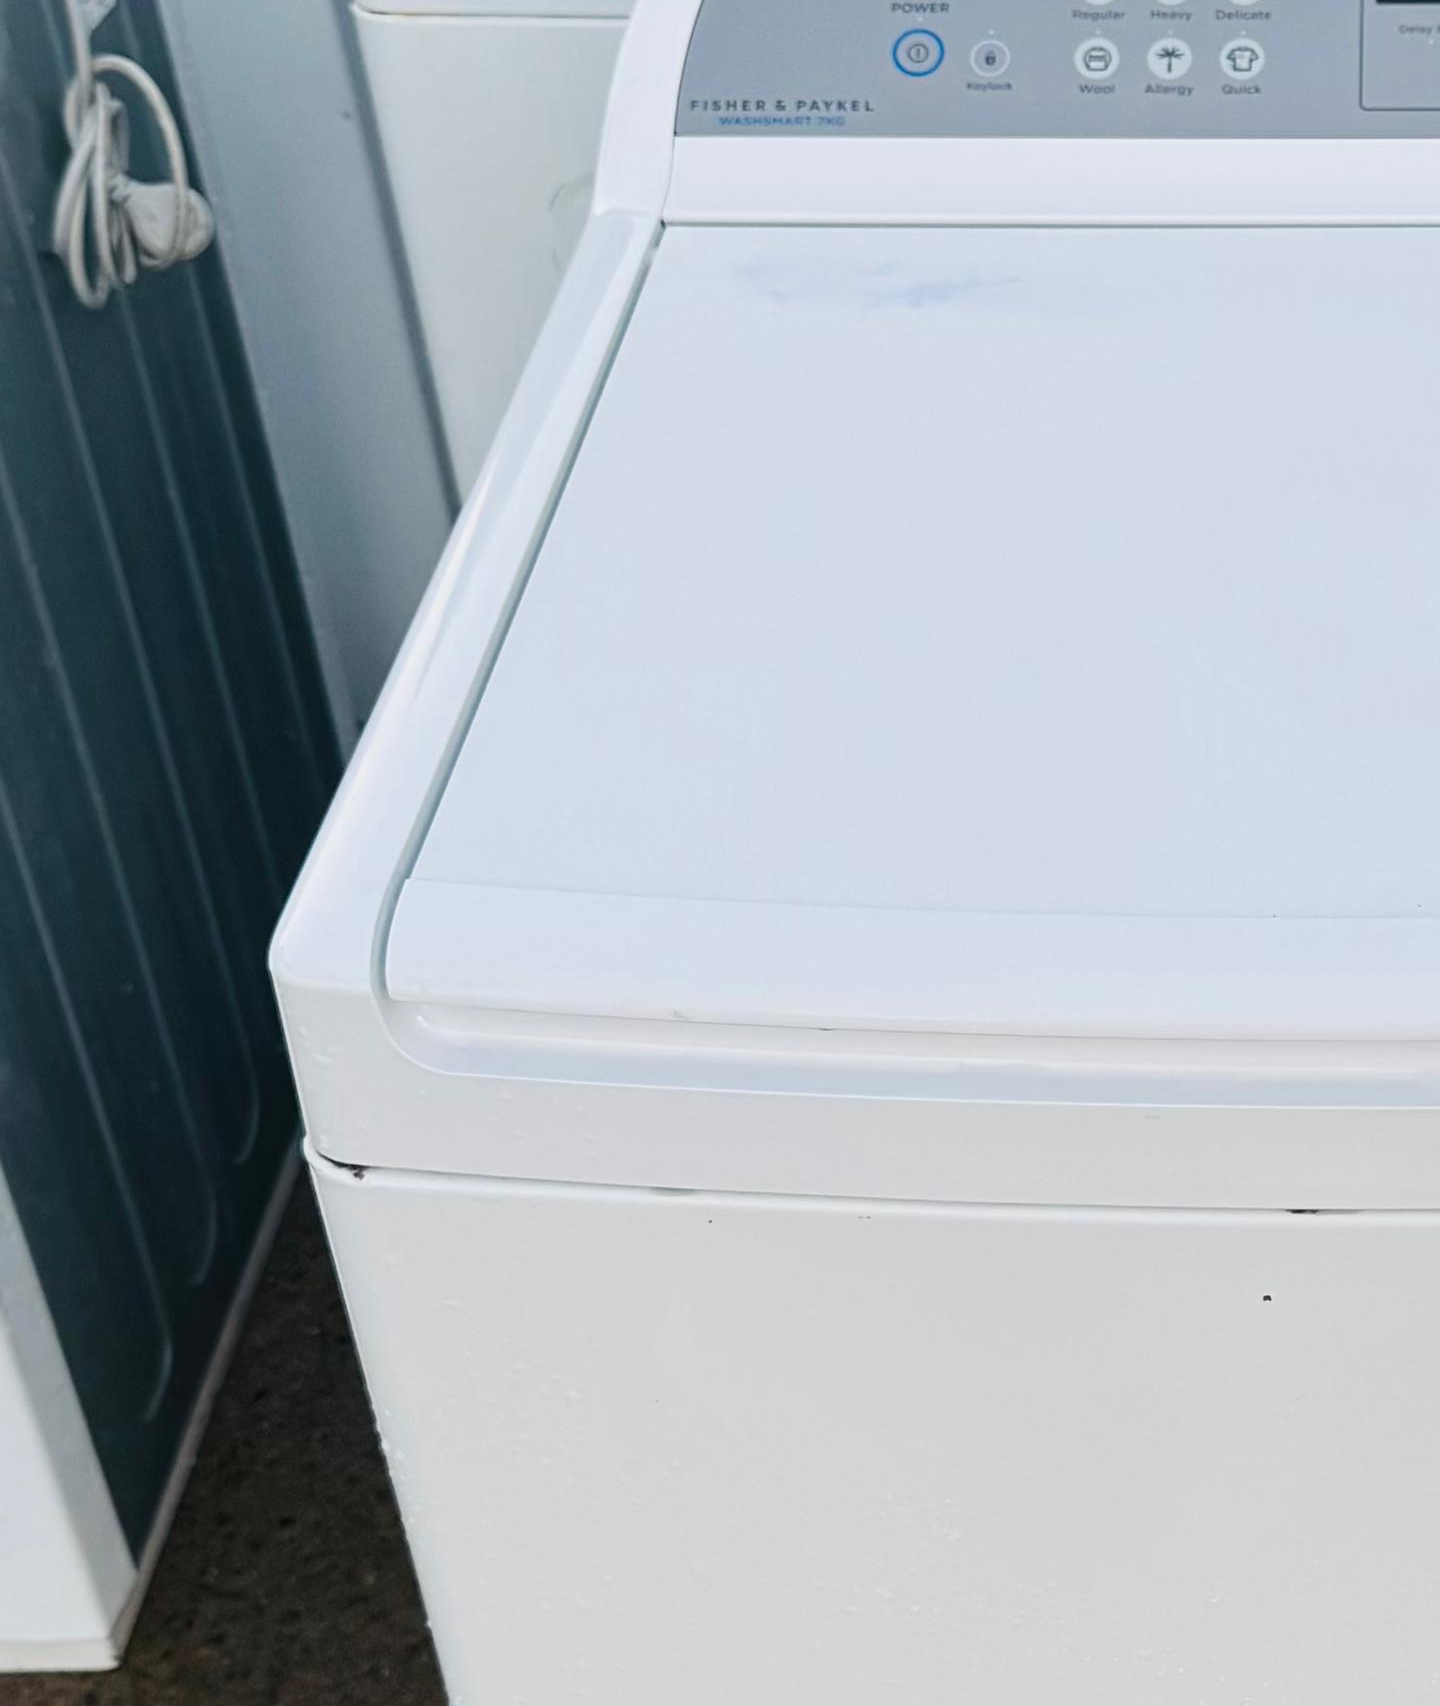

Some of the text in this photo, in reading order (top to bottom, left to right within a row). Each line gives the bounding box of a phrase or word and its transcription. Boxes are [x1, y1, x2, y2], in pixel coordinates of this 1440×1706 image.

[892, 2, 950, 13] POWER
[1072, 9, 1126, 22] Regular
[1150, 10, 1193, 22] Heavy
[1215, 9, 1272, 21] Delicate
[1078, 83, 1116, 94] Wool
[1144, 83, 1195, 97] Allergy
[1221, 83, 1262, 95] Quick
[689, 99, 876, 112] FISHER & PAYKEL
[718, 116, 812, 127] WASHSMART
